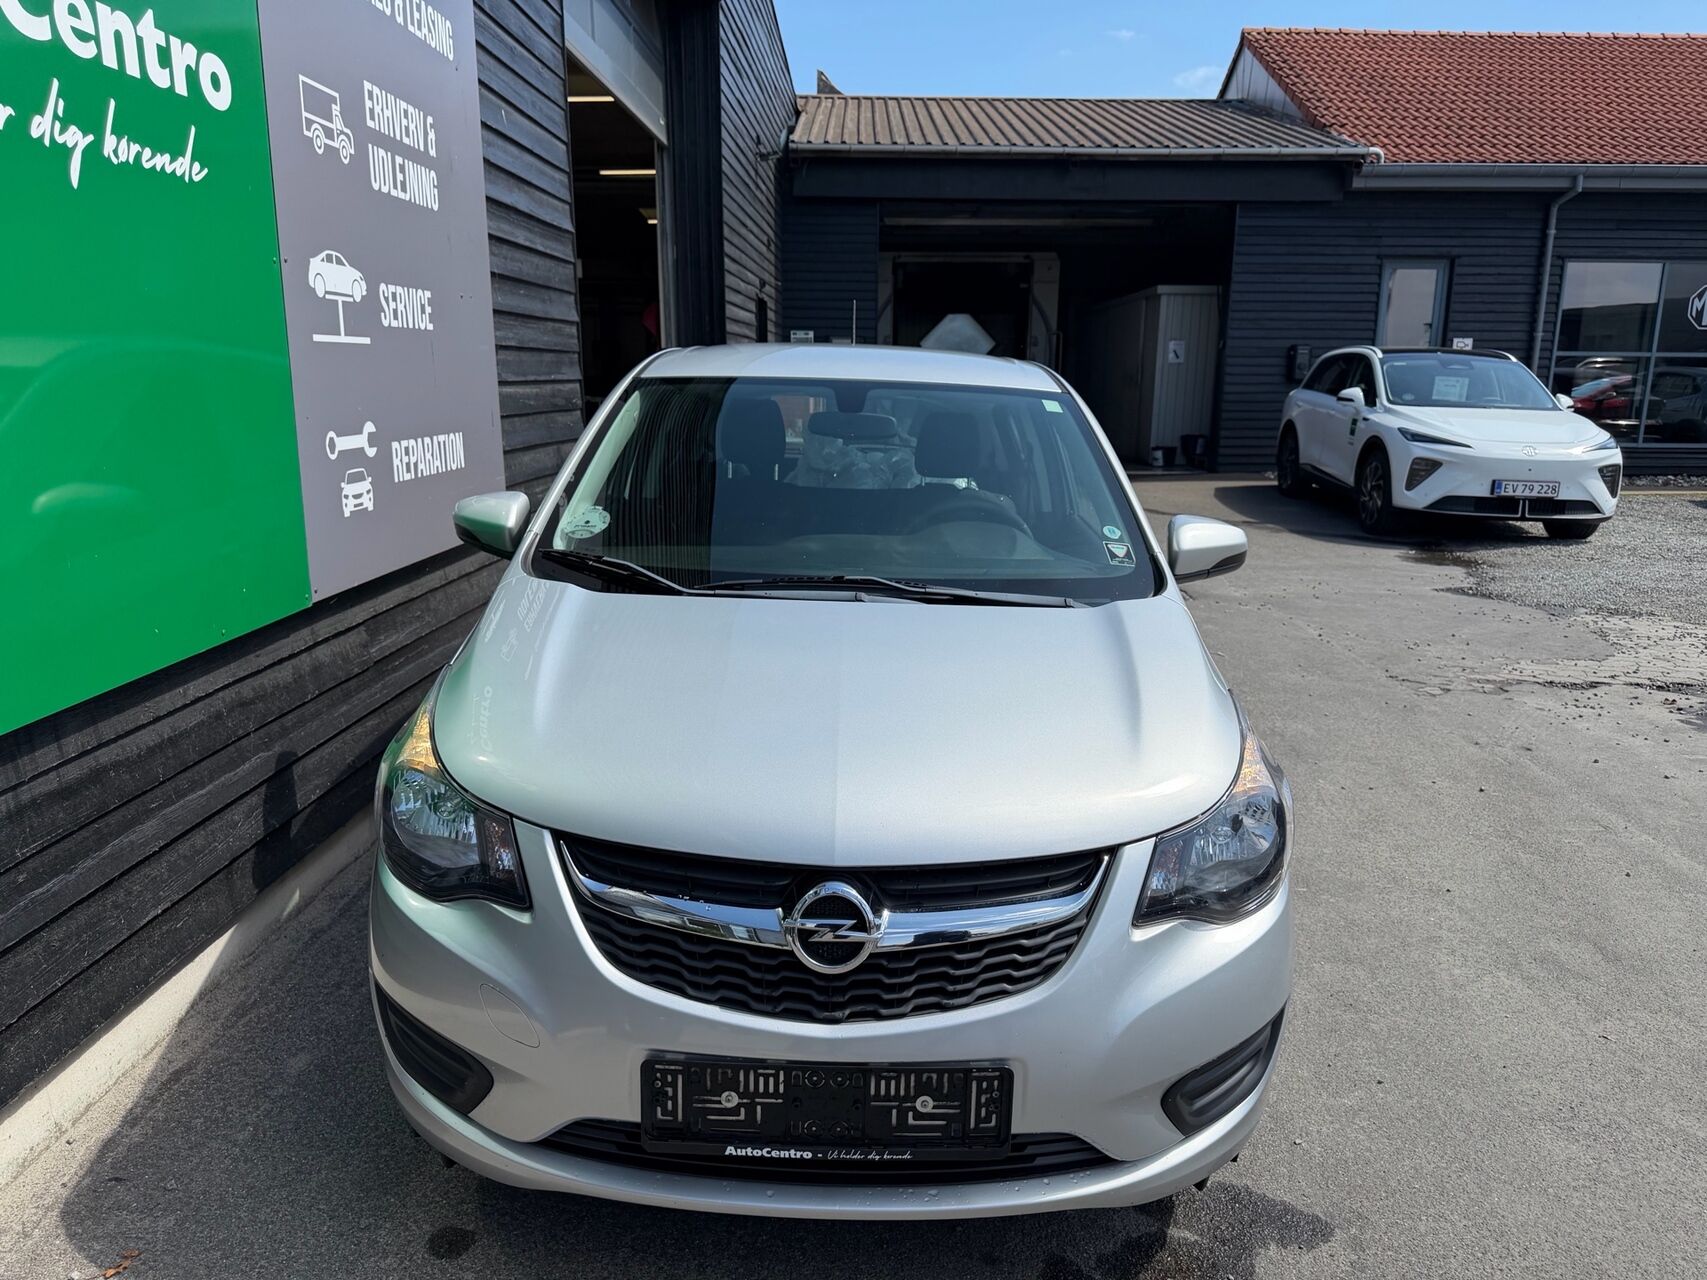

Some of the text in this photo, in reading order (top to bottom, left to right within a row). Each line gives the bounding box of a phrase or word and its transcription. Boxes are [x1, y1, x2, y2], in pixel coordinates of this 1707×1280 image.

[406, 0, 454, 61] LEASING
[30, 77, 95, 190] dig
[103, 98, 208, 184] kørende
[363, 80, 437, 158] ERHVERV &
[368, 143, 439, 211] UDLEJNING
[379, 282, 434, 331] SERVICE
[391, 432, 465, 483] REPARATION
[1503, 483, 1557, 495] EV 79 228
[724, 1145, 813, 1159] AutoCentro
[827, 1149, 839, 1161] Vi
